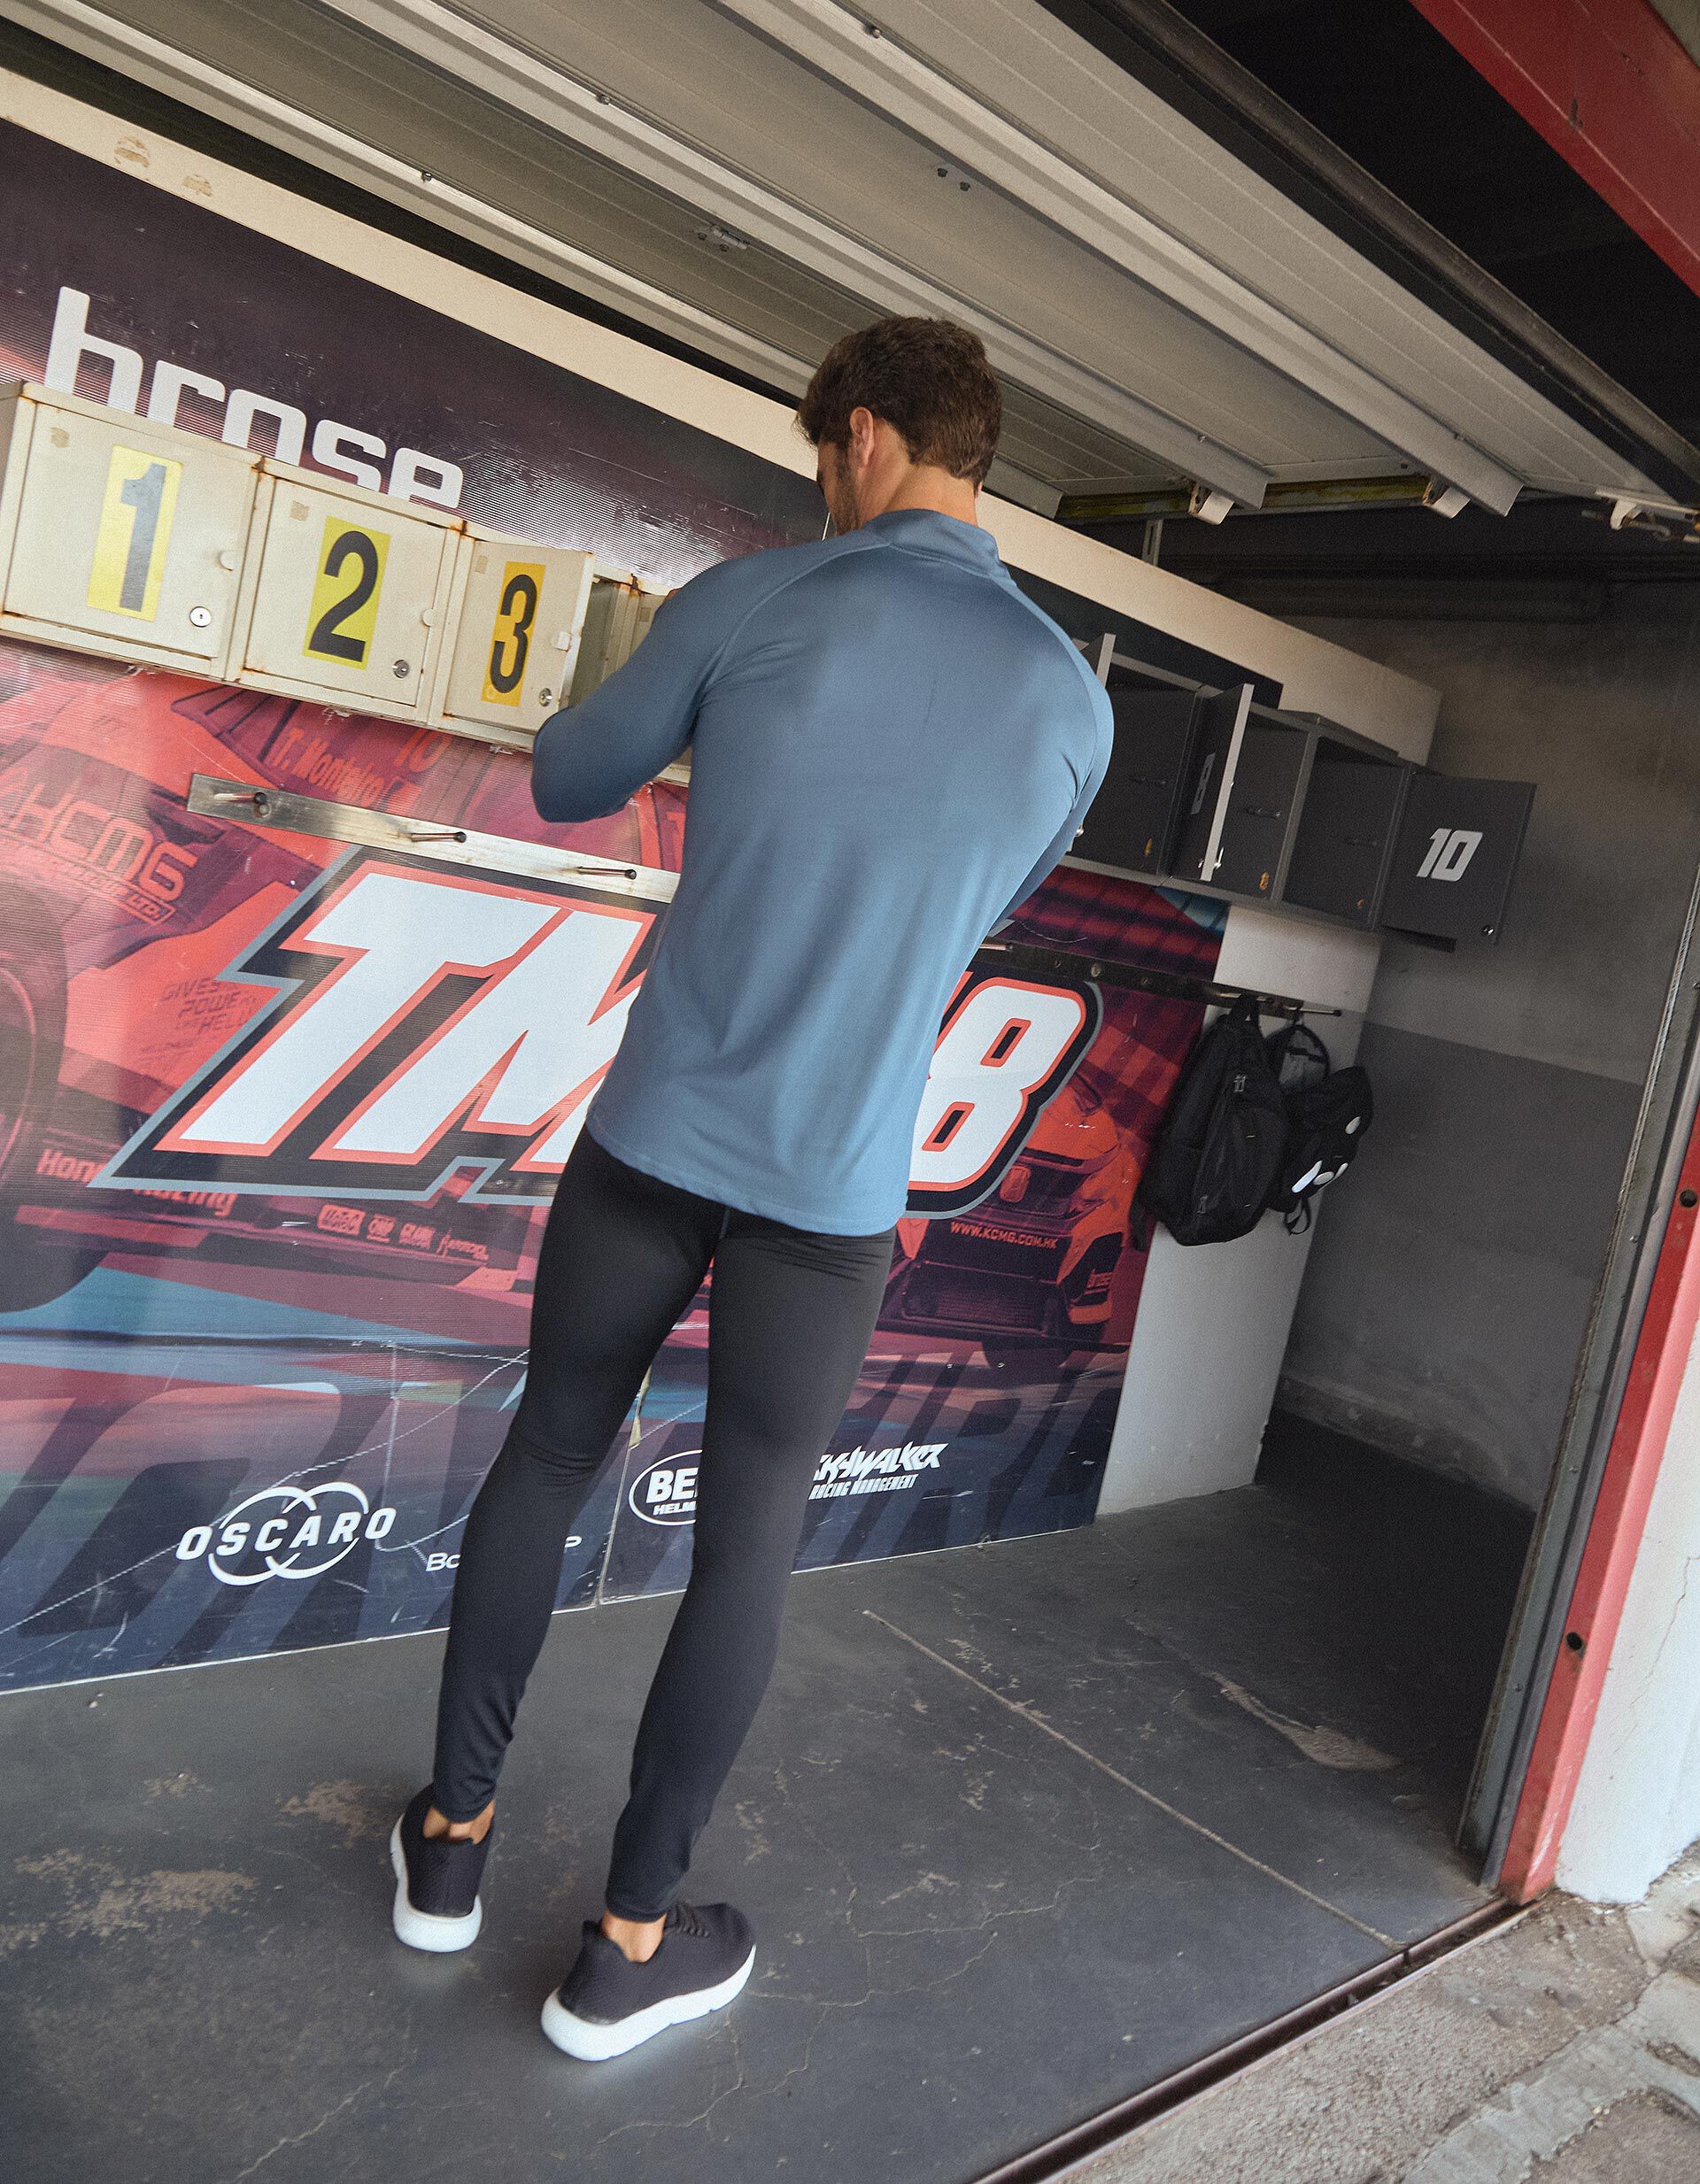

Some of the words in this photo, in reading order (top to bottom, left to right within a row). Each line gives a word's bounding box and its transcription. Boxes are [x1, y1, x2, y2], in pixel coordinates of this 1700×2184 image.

[120, 463, 167, 613] 1
[308, 530, 379, 662] 2
[489, 574, 537, 693] 3
[1416, 827, 1484, 882] 10
[645, 1467, 699, 1504] BE
[653, 1501, 697, 1516] HELM
[175, 1508, 397, 1561] OSCARO
